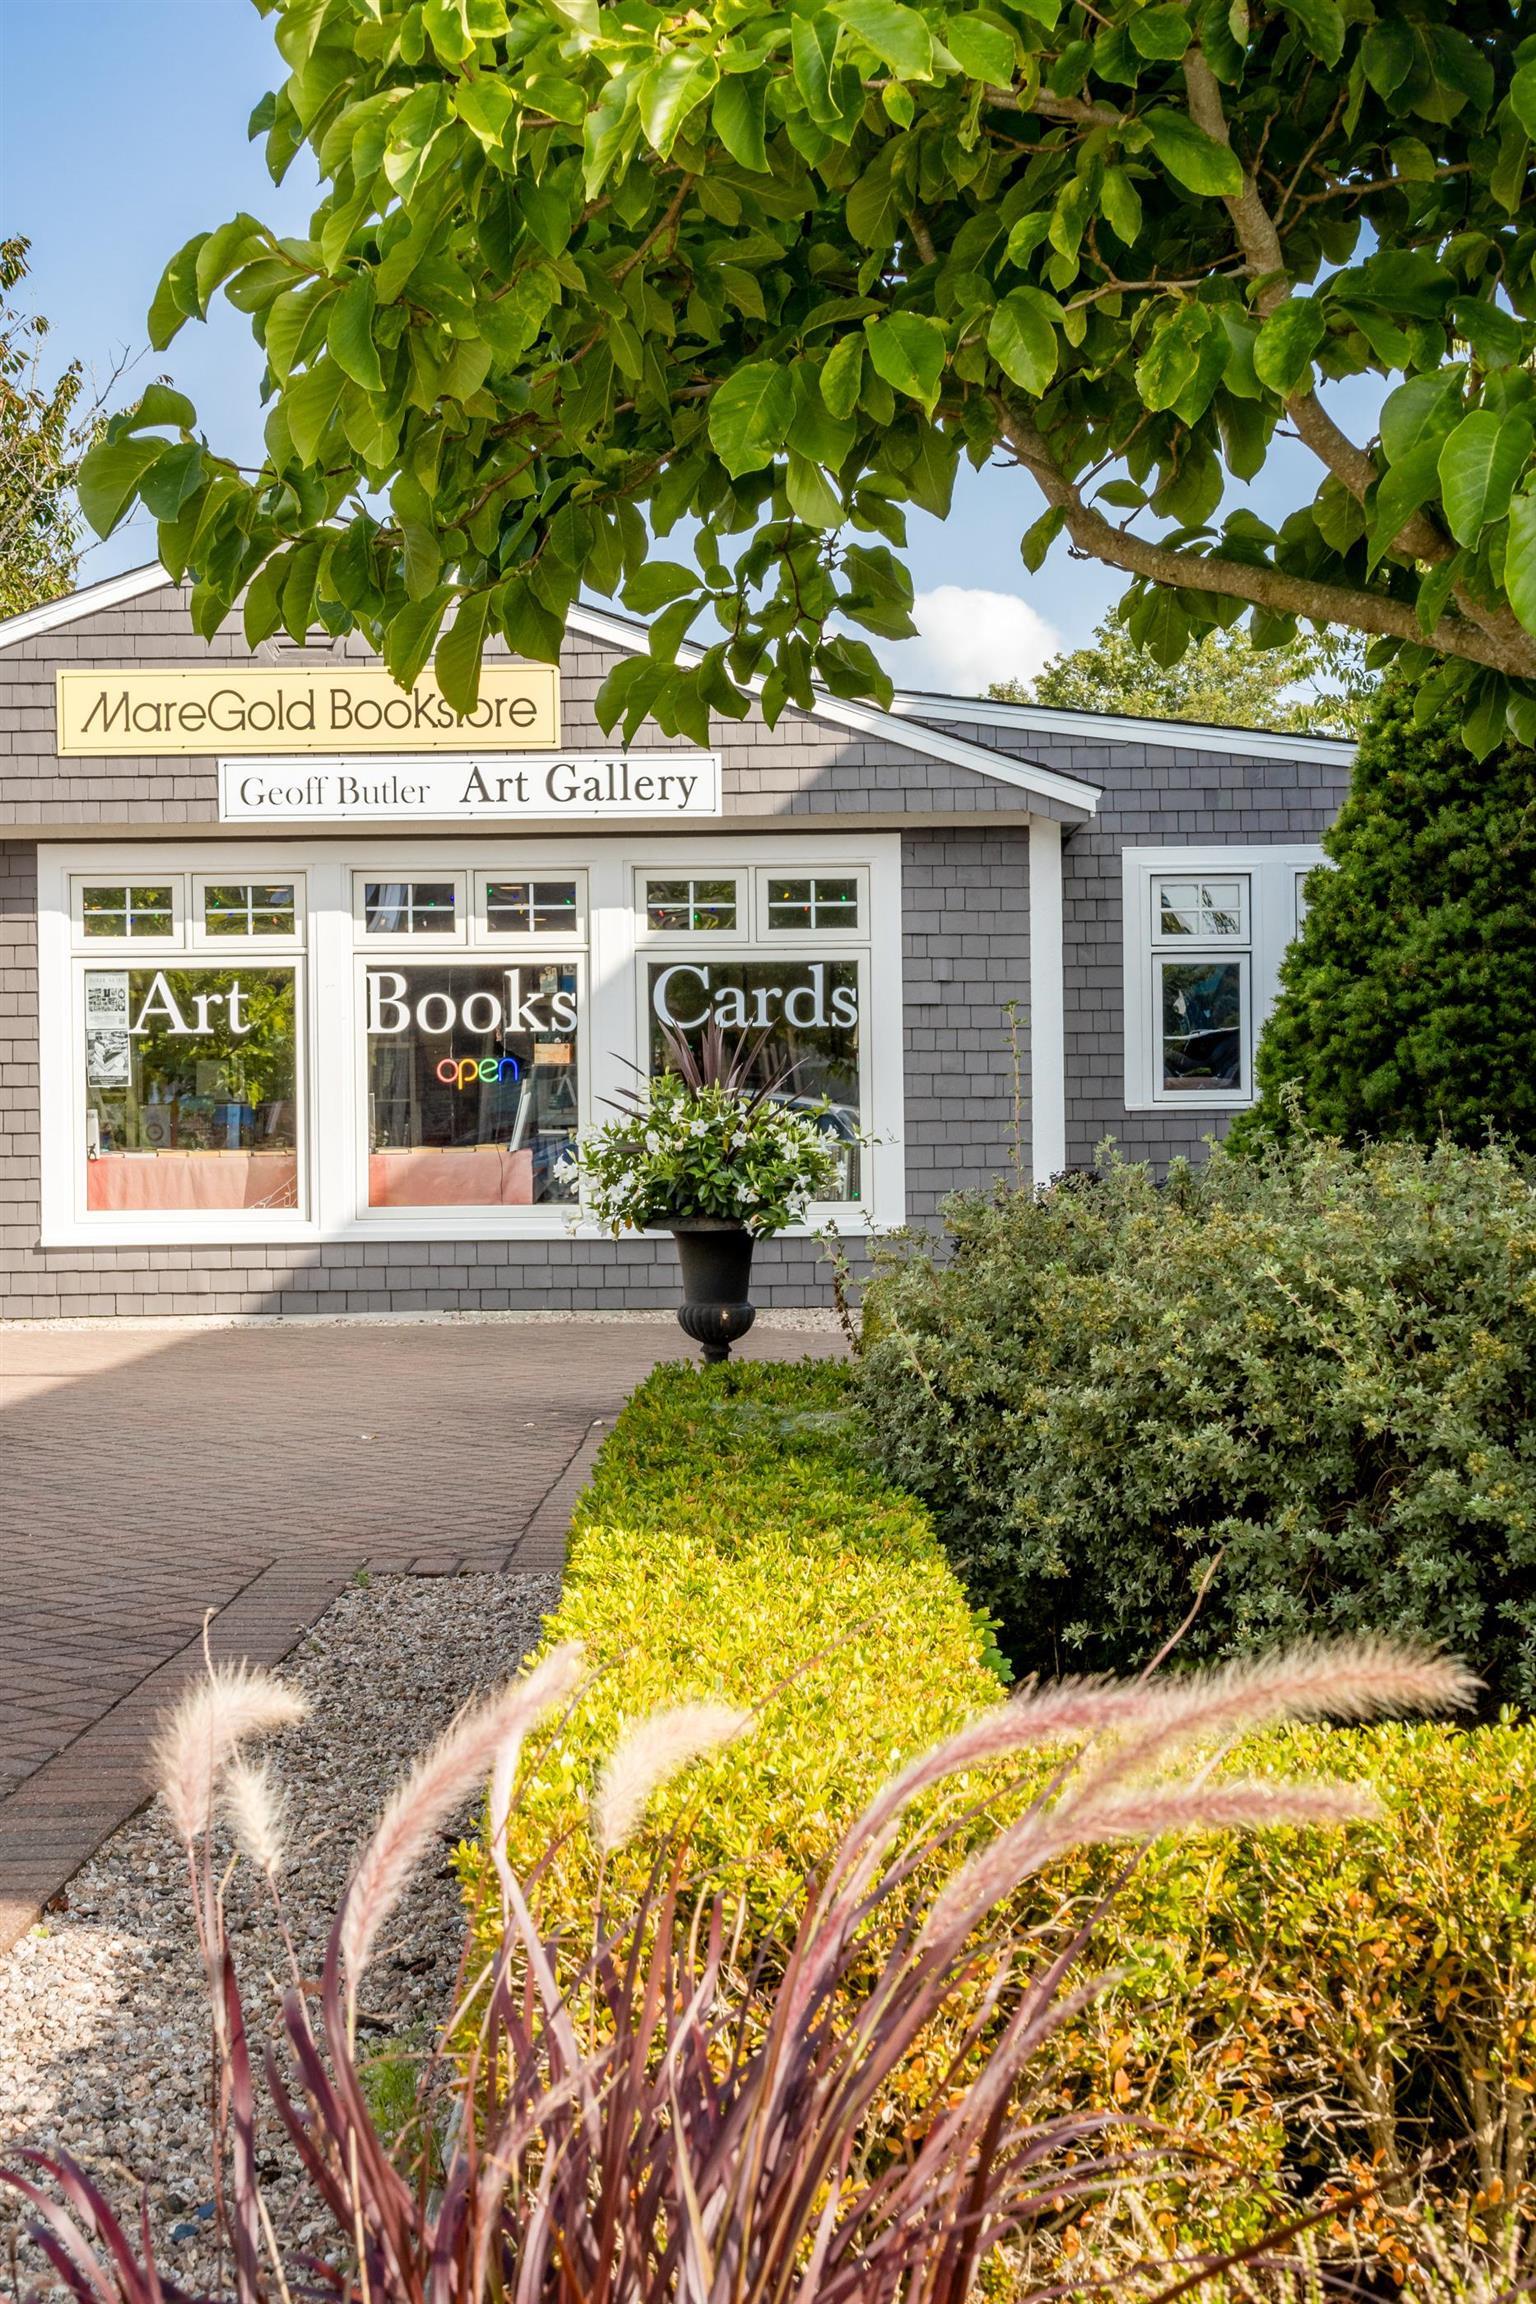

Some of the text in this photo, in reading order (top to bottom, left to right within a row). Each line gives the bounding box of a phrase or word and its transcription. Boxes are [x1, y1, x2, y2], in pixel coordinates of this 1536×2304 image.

[80, 687, 538, 733] MareGold Booksore
[239, 763, 699, 810] Geoff Butler Art Gallery
[129, 971, 252, 1035] Art
[366, 968, 578, 1034] Books
[652, 963, 859, 1030] Cards
[437, 1057, 518, 1090] open
